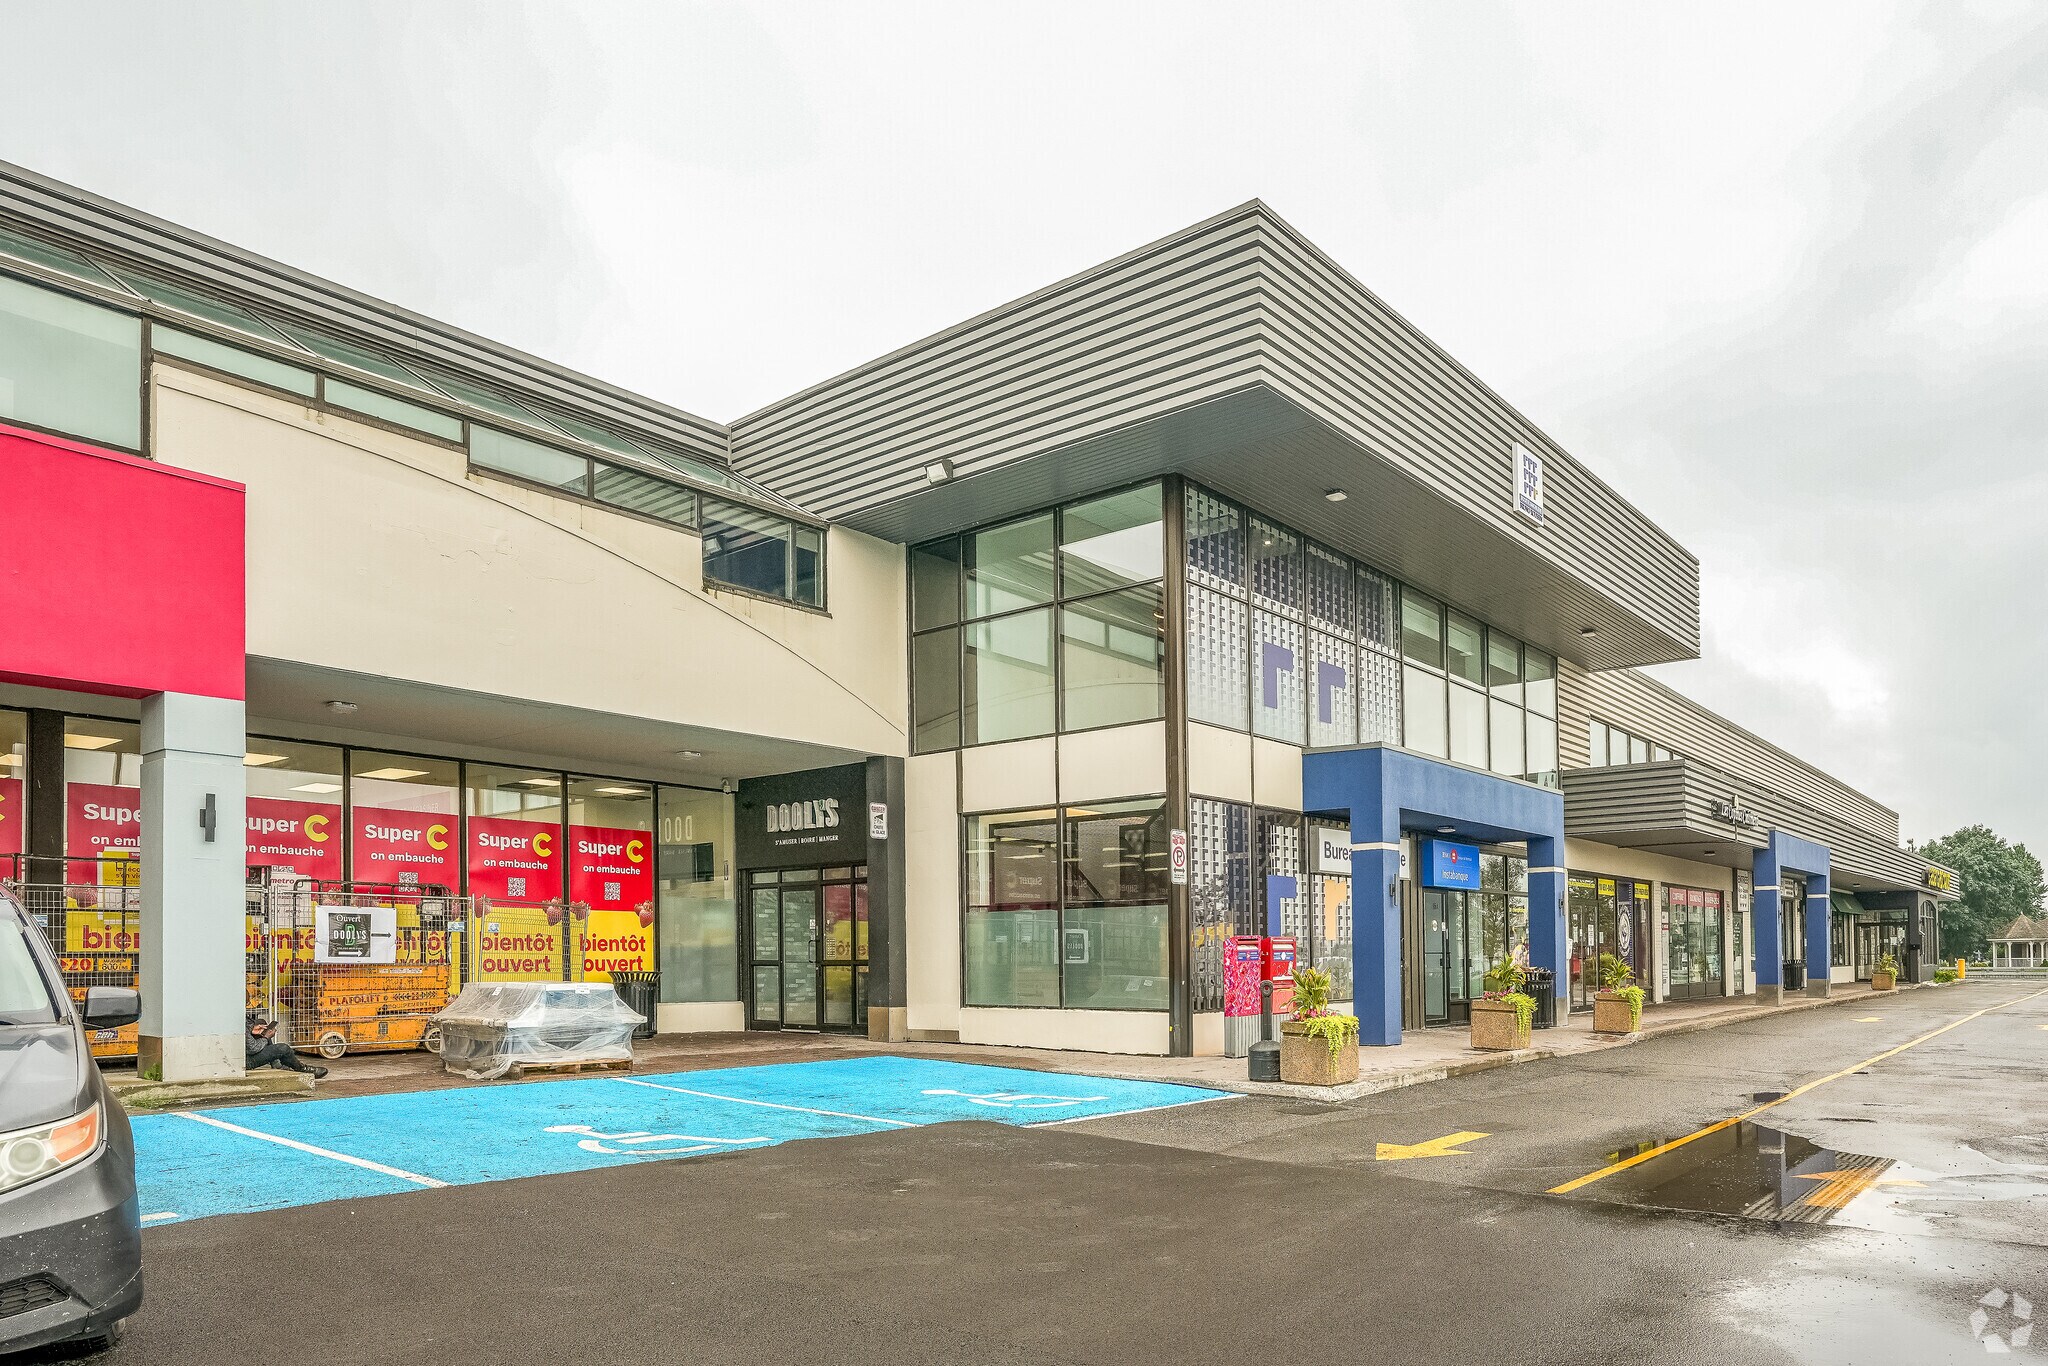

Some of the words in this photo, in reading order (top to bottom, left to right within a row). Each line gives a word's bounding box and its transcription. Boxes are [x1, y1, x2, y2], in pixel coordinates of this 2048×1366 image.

[246, 816, 299, 835] uper
[304, 814, 330, 842] C
[91, 836, 110, 845] on
[364, 824, 422, 844] Super
[426, 824, 449, 850] C
[818, 834, 839, 843] MANGER
[260, 843, 325, 857] embauche
[478, 832, 529, 851] Super
[532, 832, 553, 858] C
[577, 840, 624, 857] Super
[626, 839, 645, 863] C
[370, 852, 386, 860] on
[387, 852, 445, 864] embauche
[483, 859, 497, 867] on
[498, 859, 549, 870] embauche
[582, 865, 595, 873] on
[596, 865, 641, 875] embauche
[1441, 869, 1469, 883] Instabanque
[336, 914, 362, 923] Ouvert
[480, 932, 554, 951] bientôt
[579, 933, 646, 951] bientôt
[482, 955, 551, 972] ouvert
[583, 955, 643, 972] ouvert
